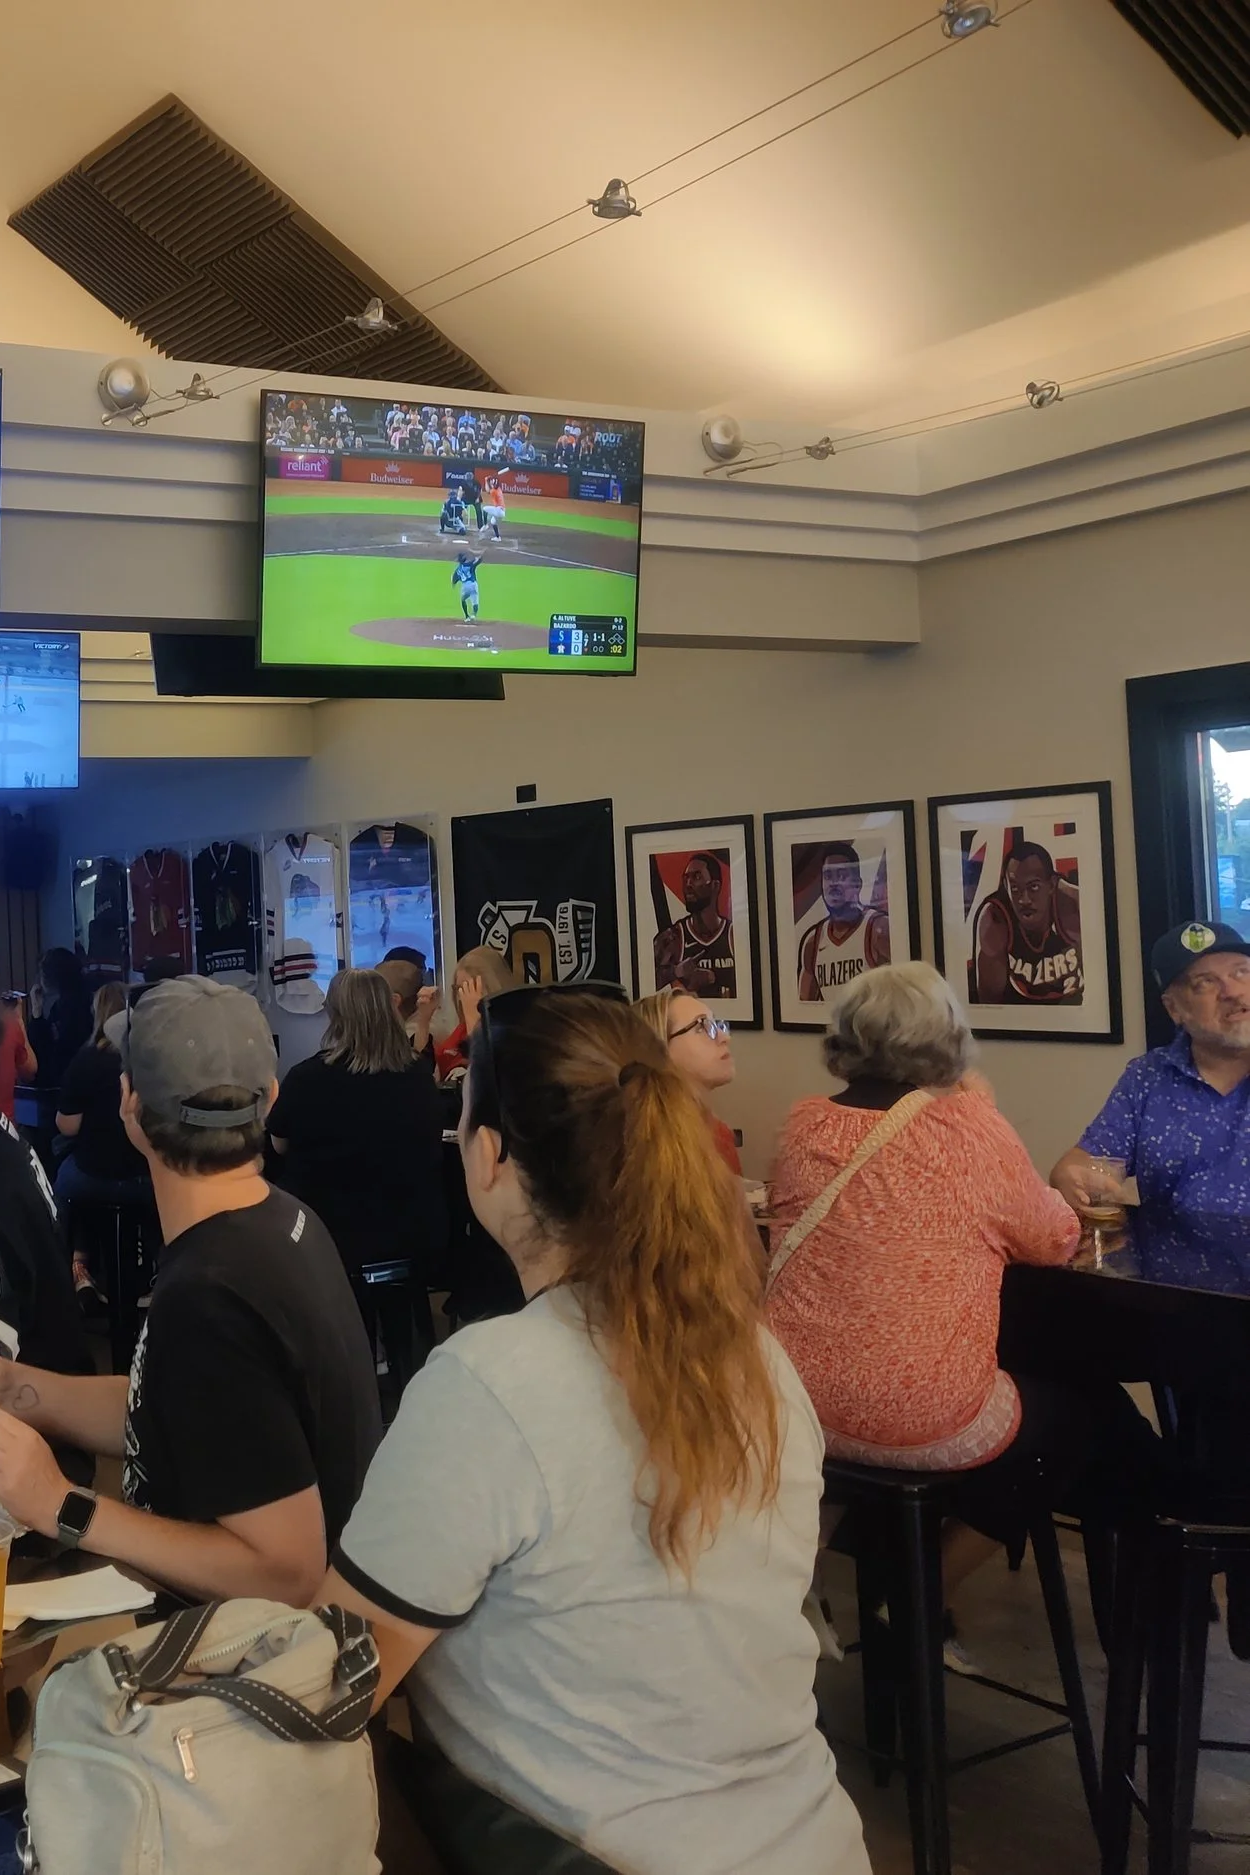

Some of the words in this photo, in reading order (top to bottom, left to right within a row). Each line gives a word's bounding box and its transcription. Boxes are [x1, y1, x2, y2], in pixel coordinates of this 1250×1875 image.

[593, 431, 623, 444] ROOT
[287, 459, 323, 472] reliant
[370, 473, 414, 485] Budweiser
[501, 482, 543, 496] Budweiser
[574, 632, 580, 641] 3
[583, 638, 589, 647] 7
[573, 644, 580, 653] 0
[558, 906, 569, 934] 1976
[559, 940, 573, 965] EST.
